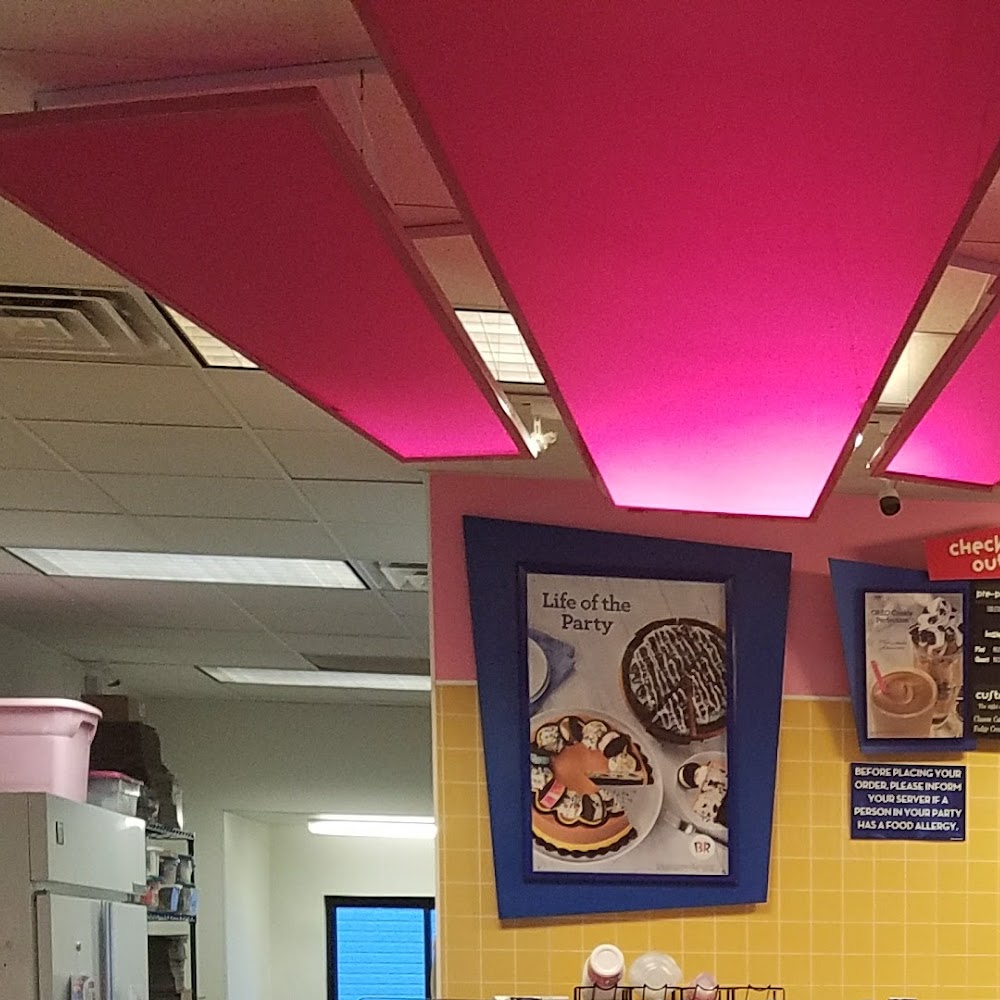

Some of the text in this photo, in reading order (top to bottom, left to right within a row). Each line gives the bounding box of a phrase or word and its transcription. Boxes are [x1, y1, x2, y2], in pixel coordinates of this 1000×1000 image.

[542, 592, 631, 612] Life of the
[561, 613, 614, 635] Party
[855, 767, 962, 778] BEFORE PLACING YOUR
[890, 781, 924, 791] PLEASE
[925, 783, 962, 791] INFORM
[868, 794, 949, 804] YOUR SERVER IF A
[854, 807, 962, 817] PERSON IN YOUR PARTY
[857, 820, 877, 829] HAS
[877, 821, 885, 829] A
[886, 821, 914, 830] FOOD
